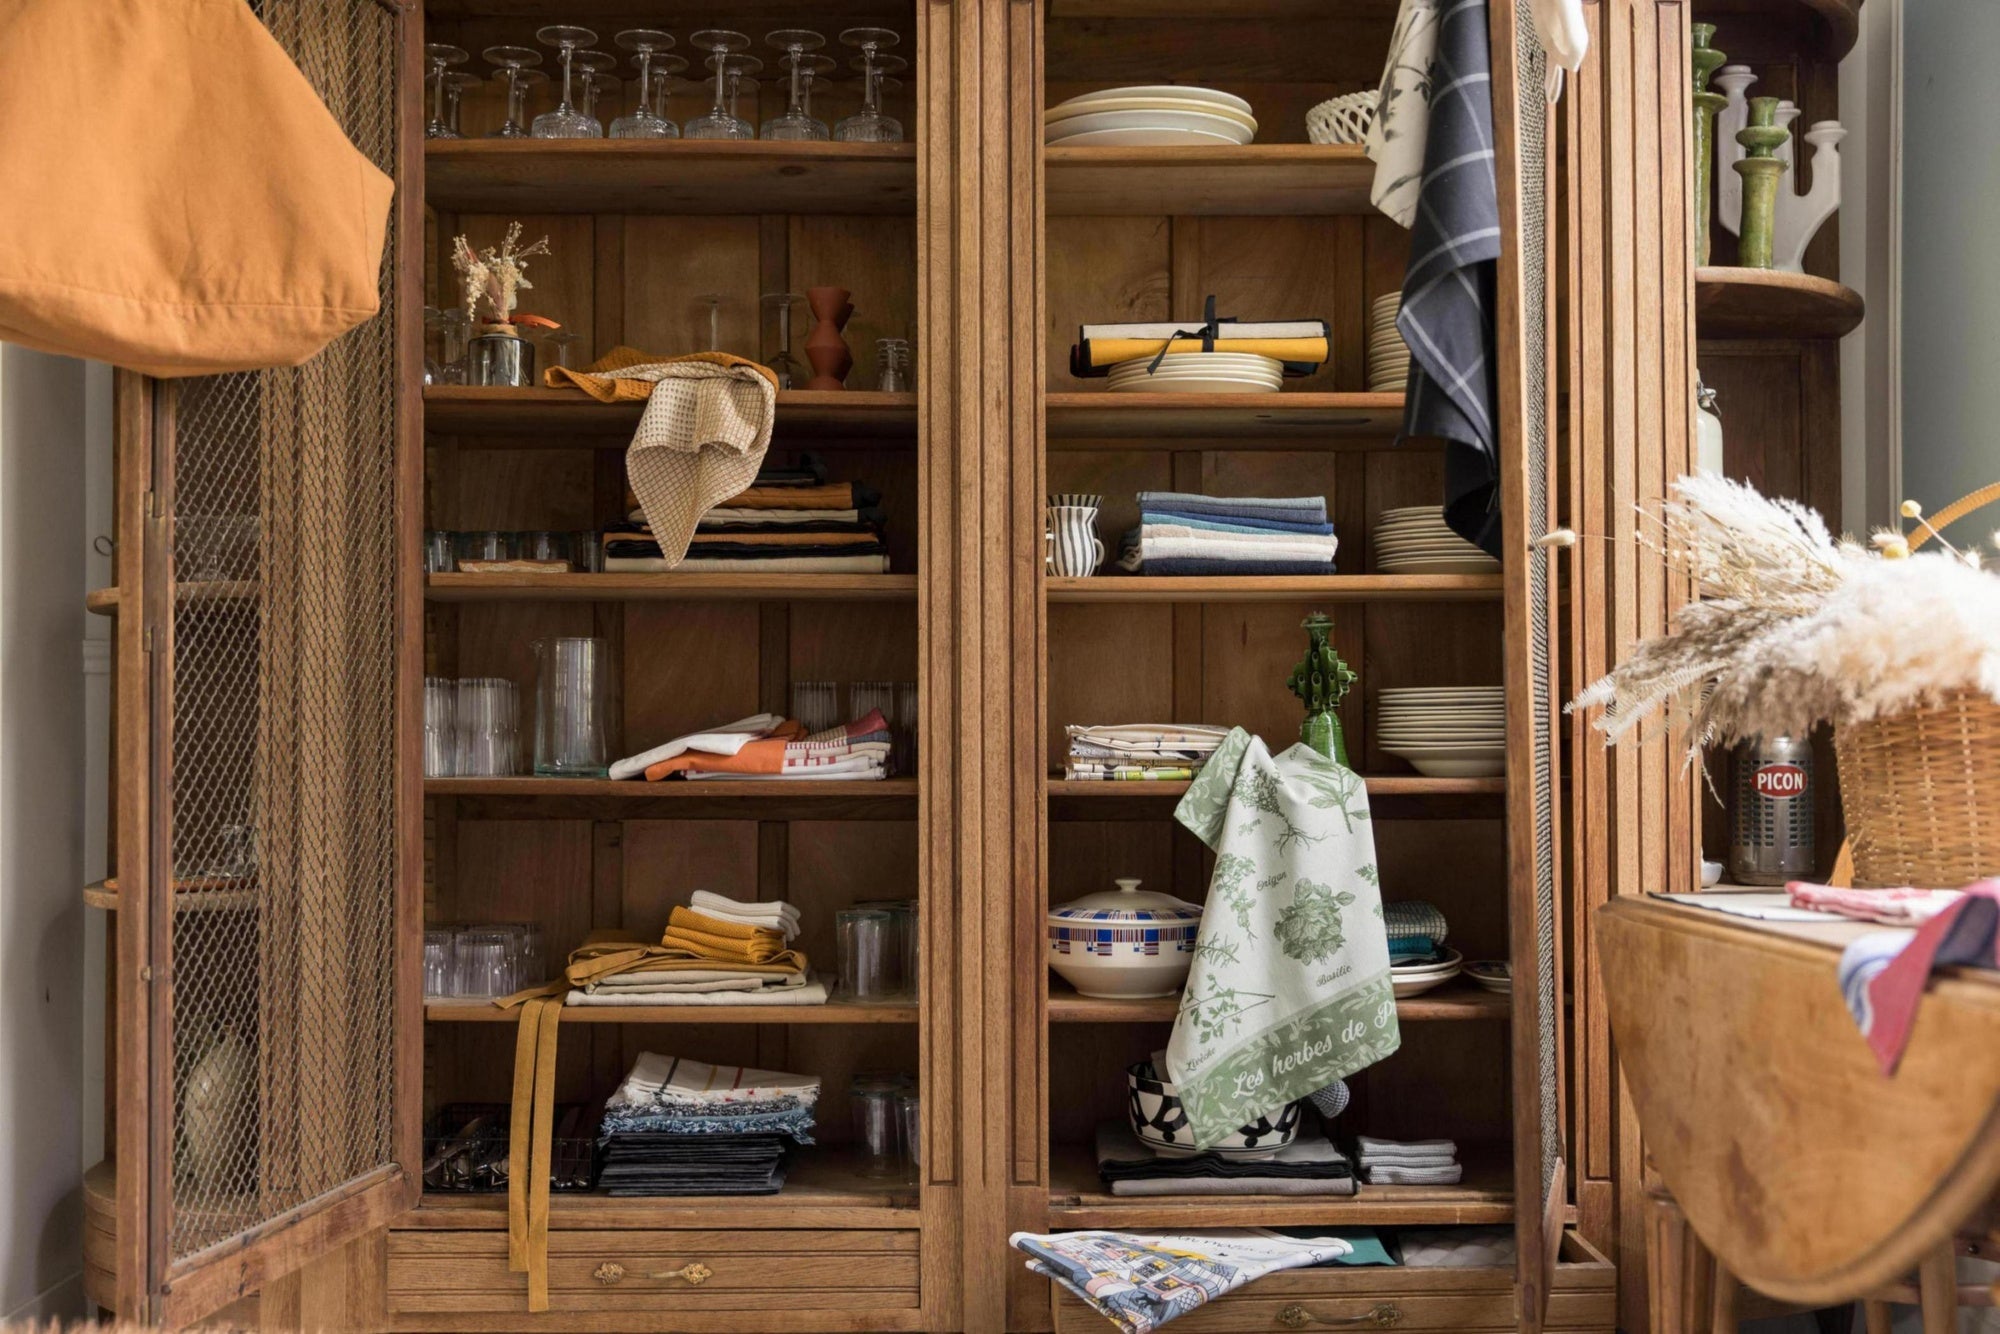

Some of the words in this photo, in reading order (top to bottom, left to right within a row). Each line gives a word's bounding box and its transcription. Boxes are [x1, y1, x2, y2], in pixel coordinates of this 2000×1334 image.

[1757, 772, 1803, 790] PICON
[1256, 871, 1287, 891] Origan
[1316, 965, 1352, 987] Basilic
[1231, 1067, 1265, 1099] Les
[1272, 1034, 1333, 1077] herbes
[1341, 1019, 1367, 1043] de
[1374, 1000, 1396, 1028] P
